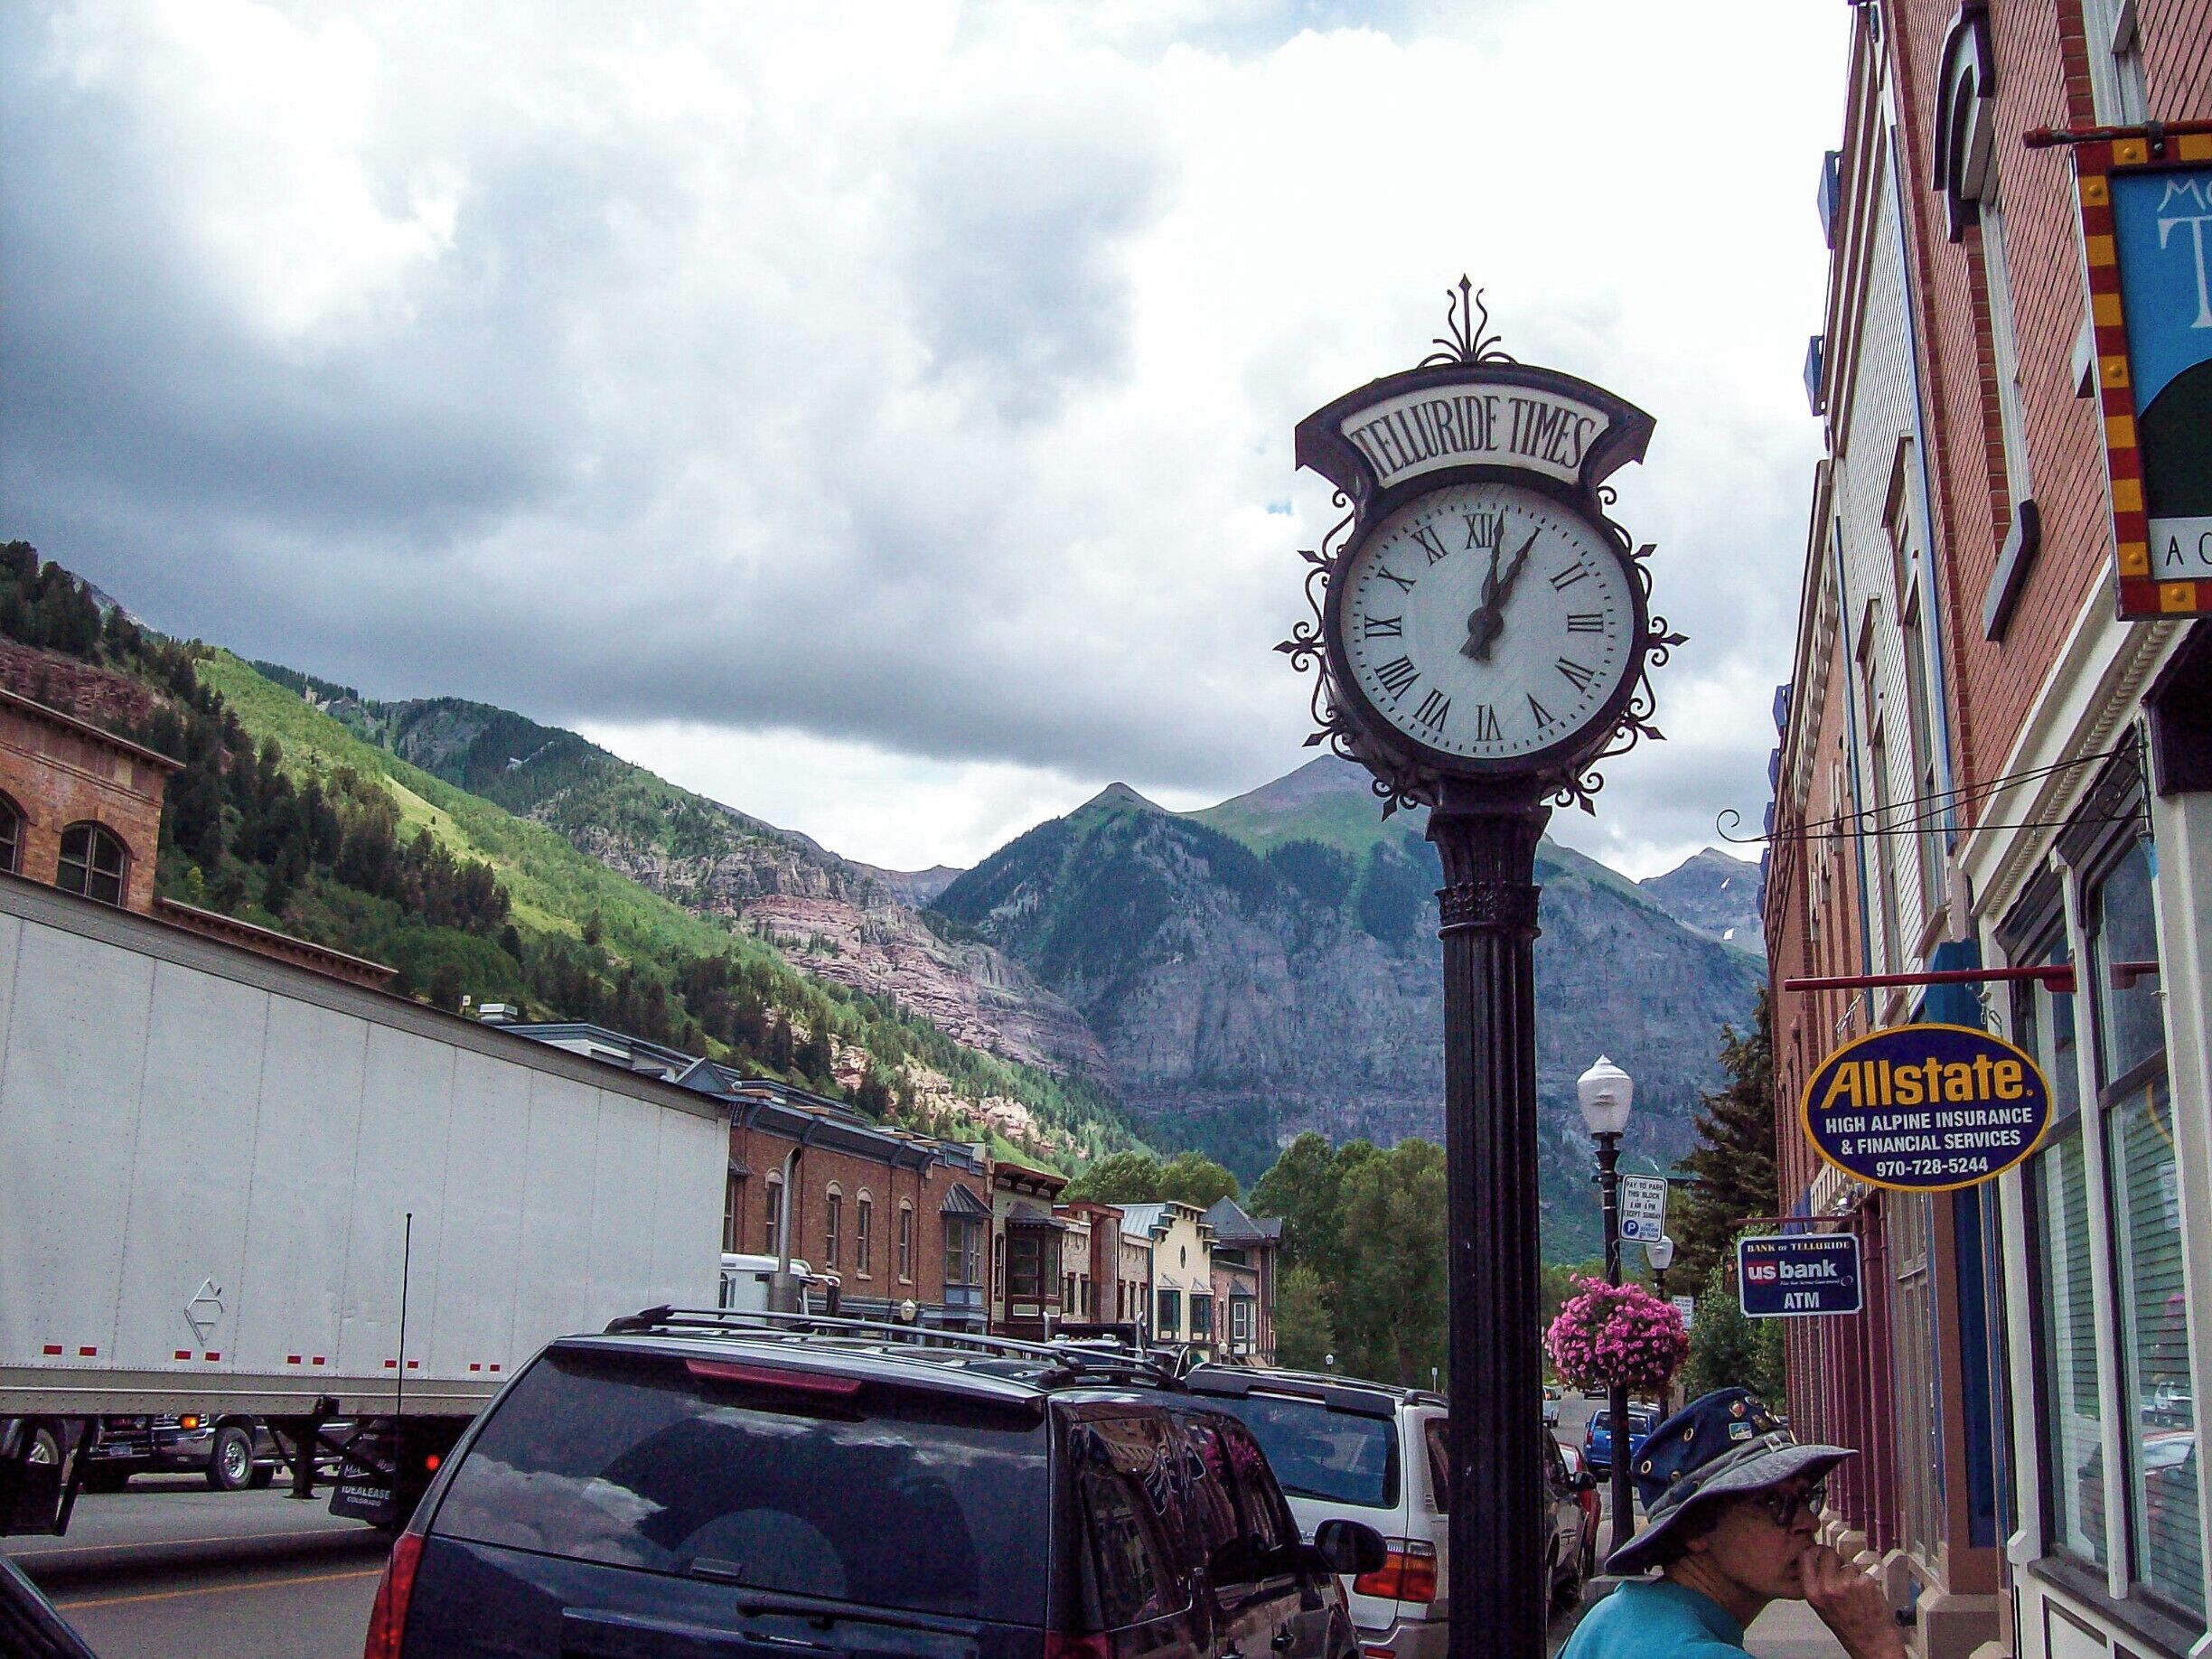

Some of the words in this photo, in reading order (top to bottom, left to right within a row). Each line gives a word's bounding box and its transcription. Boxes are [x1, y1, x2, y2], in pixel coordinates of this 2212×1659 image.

[1350, 395, 1501, 479] TELLURIDE
[1508, 397, 1596, 469] TIMES
[1463, 513, 1493, 549] XII
[1411, 526, 1448, 566] XI
[1376, 566, 1416, 595] X
[1549, 560, 1589, 592] II
[1364, 614, 1401, 639] IX
[1567, 614, 1604, 633] III
[1373, 655, 1421, 701] VIII
[1555, 656, 1595, 693] IV
[1412, 688, 1452, 732] VII
[1476, 704, 1503, 742] VI
[1526, 692, 1556, 728] V
[1825, 1116, 1865, 1134] HIGH
[1870, 1112, 1931, 1131] ALPINE
[1936, 1107, 2033, 1128] INSURANCE
[1841, 1139, 1853, 1155] &
[1857, 1135, 1941, 1154] FINANCIAL
[1944, 1129, 2021, 1150] SERVICES
[1876, 1157, 1988, 1176] 970-728-5244
[1627, 1223, 1636, 1233] P
[1748, 1244, 1776, 1252] BANK
[1790, 1241, 1850, 1251] TELLURIDE
[1748, 1265, 1776, 1280] us
[1779, 1259, 1838, 1279] bank
[1784, 1291, 1820, 1309] ATM
[342, 1486, 390, 1500] IDEALEASE
